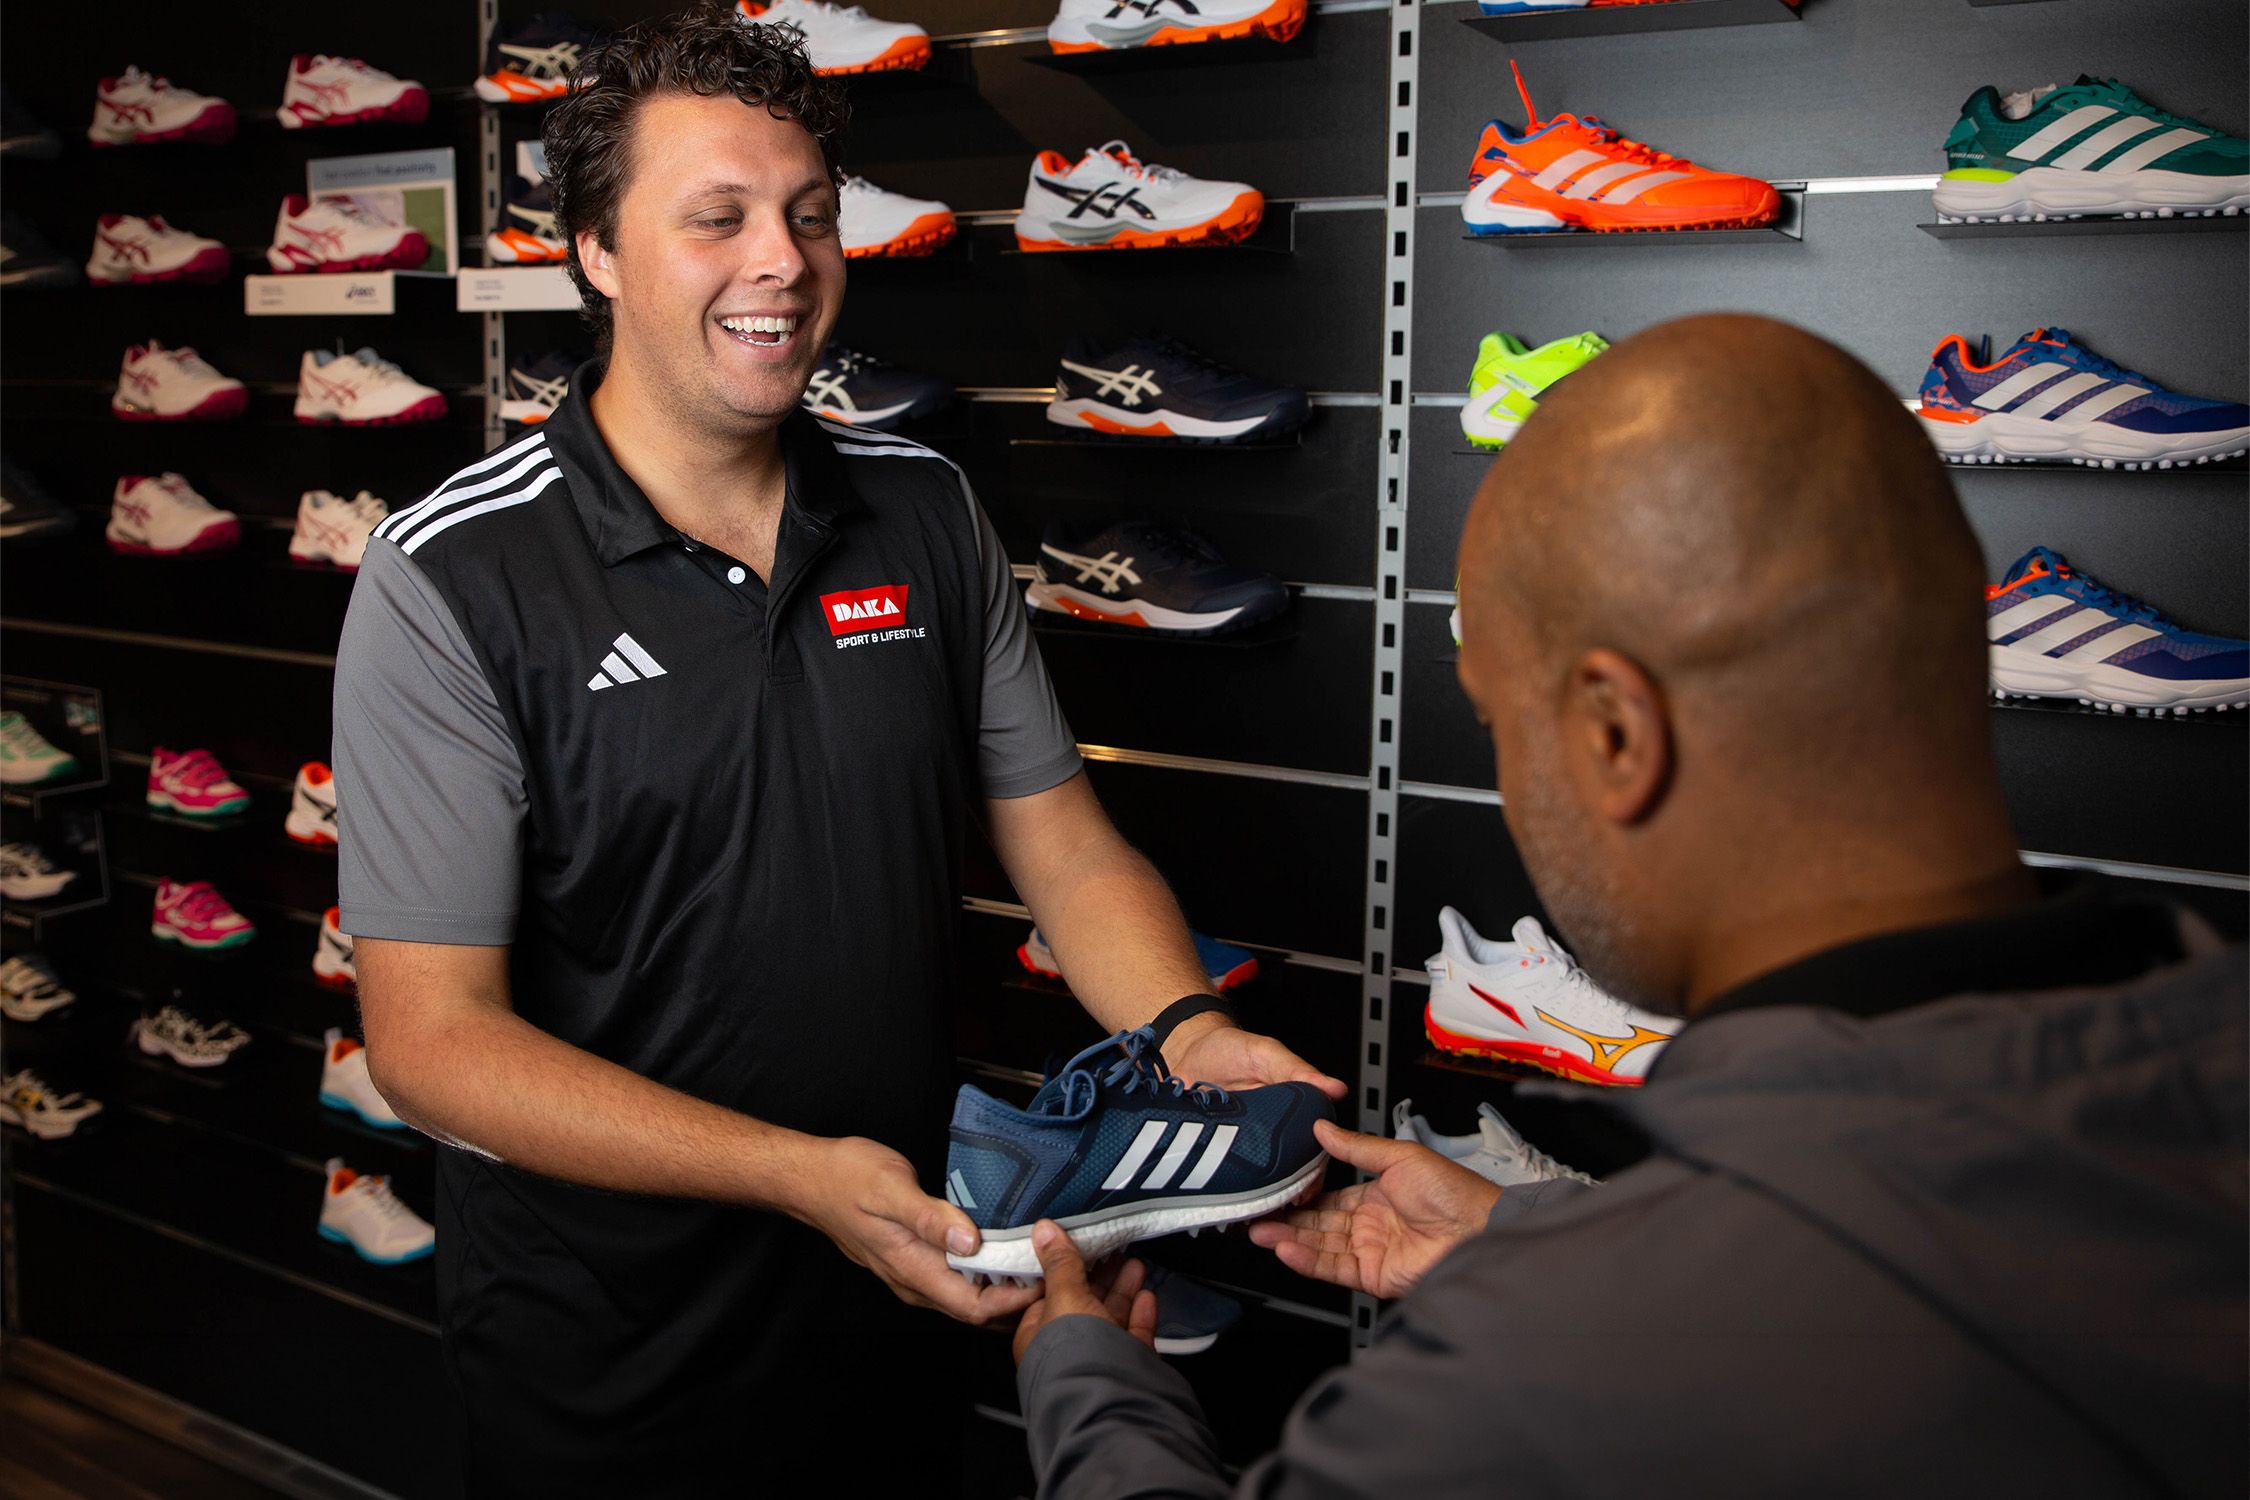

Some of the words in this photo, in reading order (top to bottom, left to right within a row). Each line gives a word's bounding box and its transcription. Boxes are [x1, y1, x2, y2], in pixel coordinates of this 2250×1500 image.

[832, 597, 899, 622] DAKA
[836, 634, 869, 648] SPORT
[871, 633, 878, 642] &
[880, 627, 925, 641] LIFESTYLE
